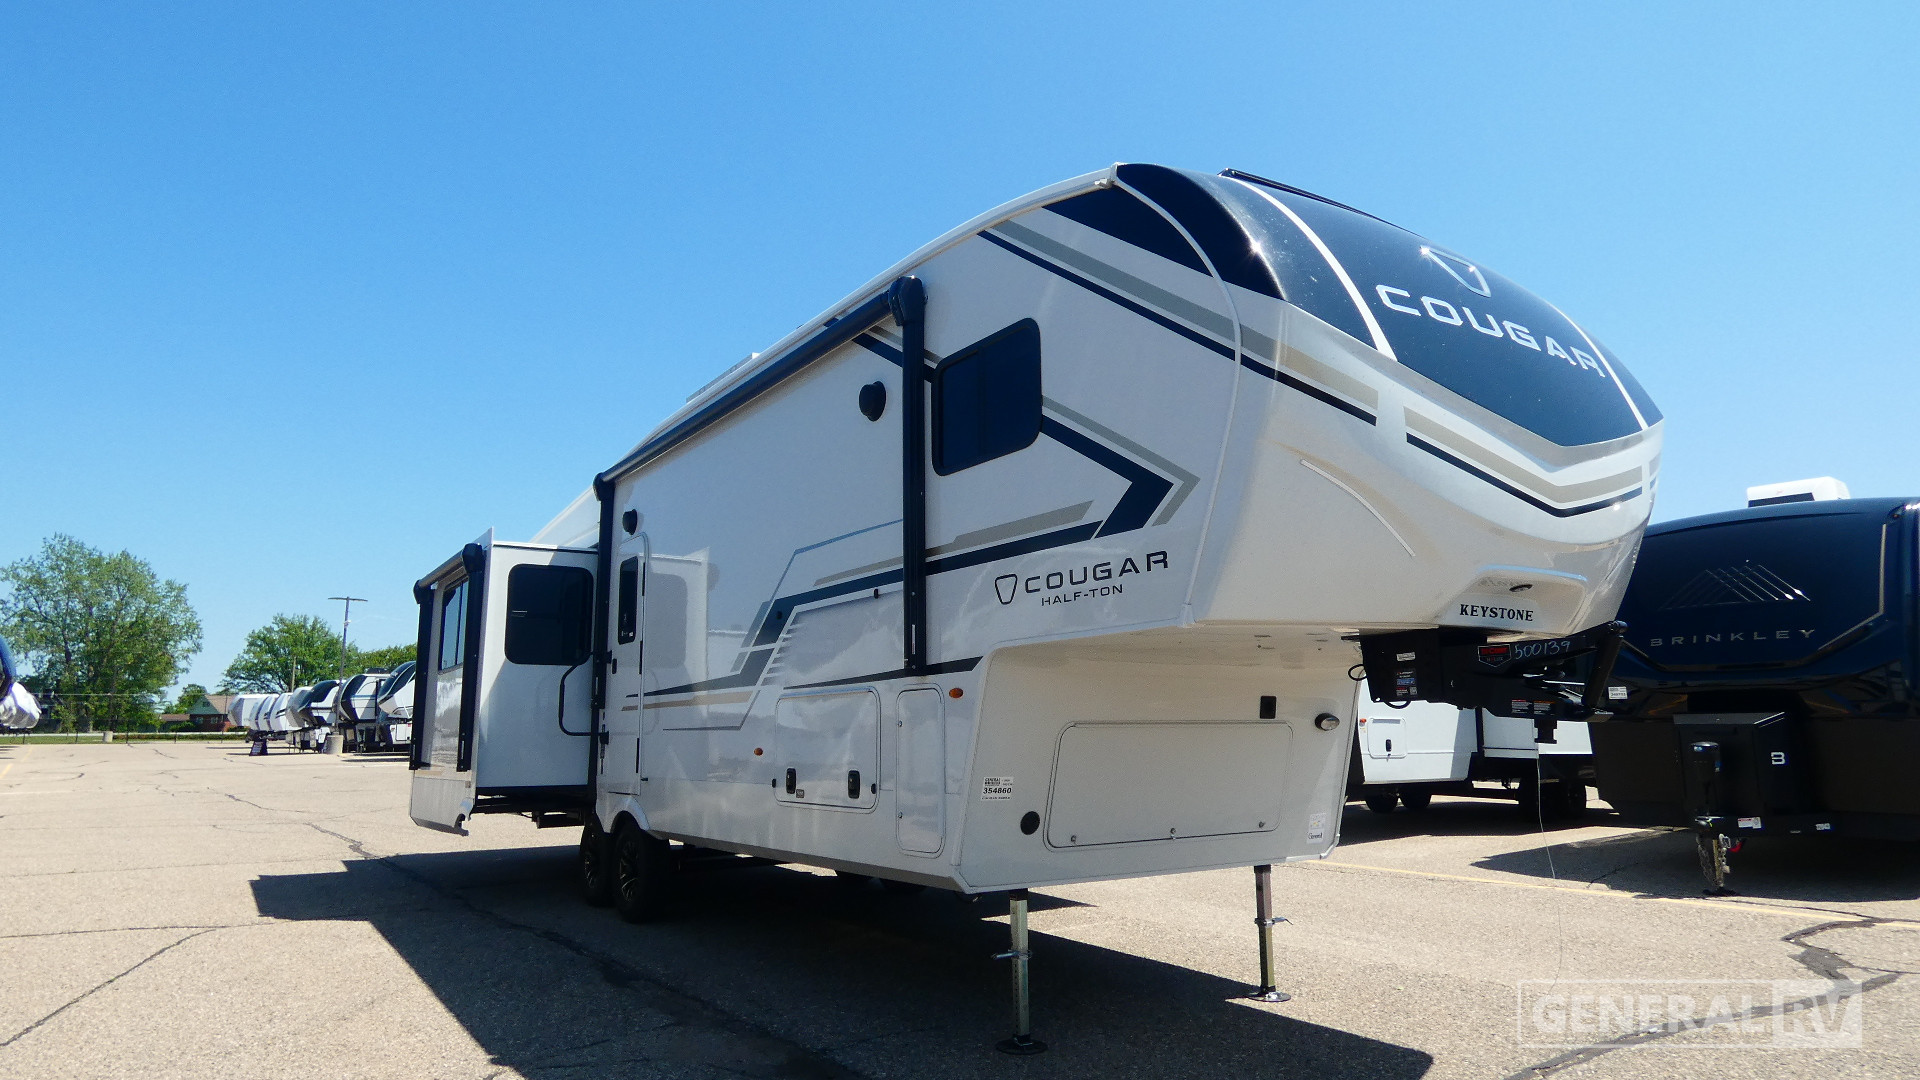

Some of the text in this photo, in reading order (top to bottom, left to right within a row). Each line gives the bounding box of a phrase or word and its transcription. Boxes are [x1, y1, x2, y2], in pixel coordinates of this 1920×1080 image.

[1375, 284, 1606, 378] COUGAR
[1024, 550, 1169, 594] COUGAR
[1041, 584, 1123, 606] HALF-TON
[1459, 603, 1534, 622] KEYSTONE
[1650, 629, 1815, 648] BRINKLEY
[1514, 640, 1571, 660] 500139
